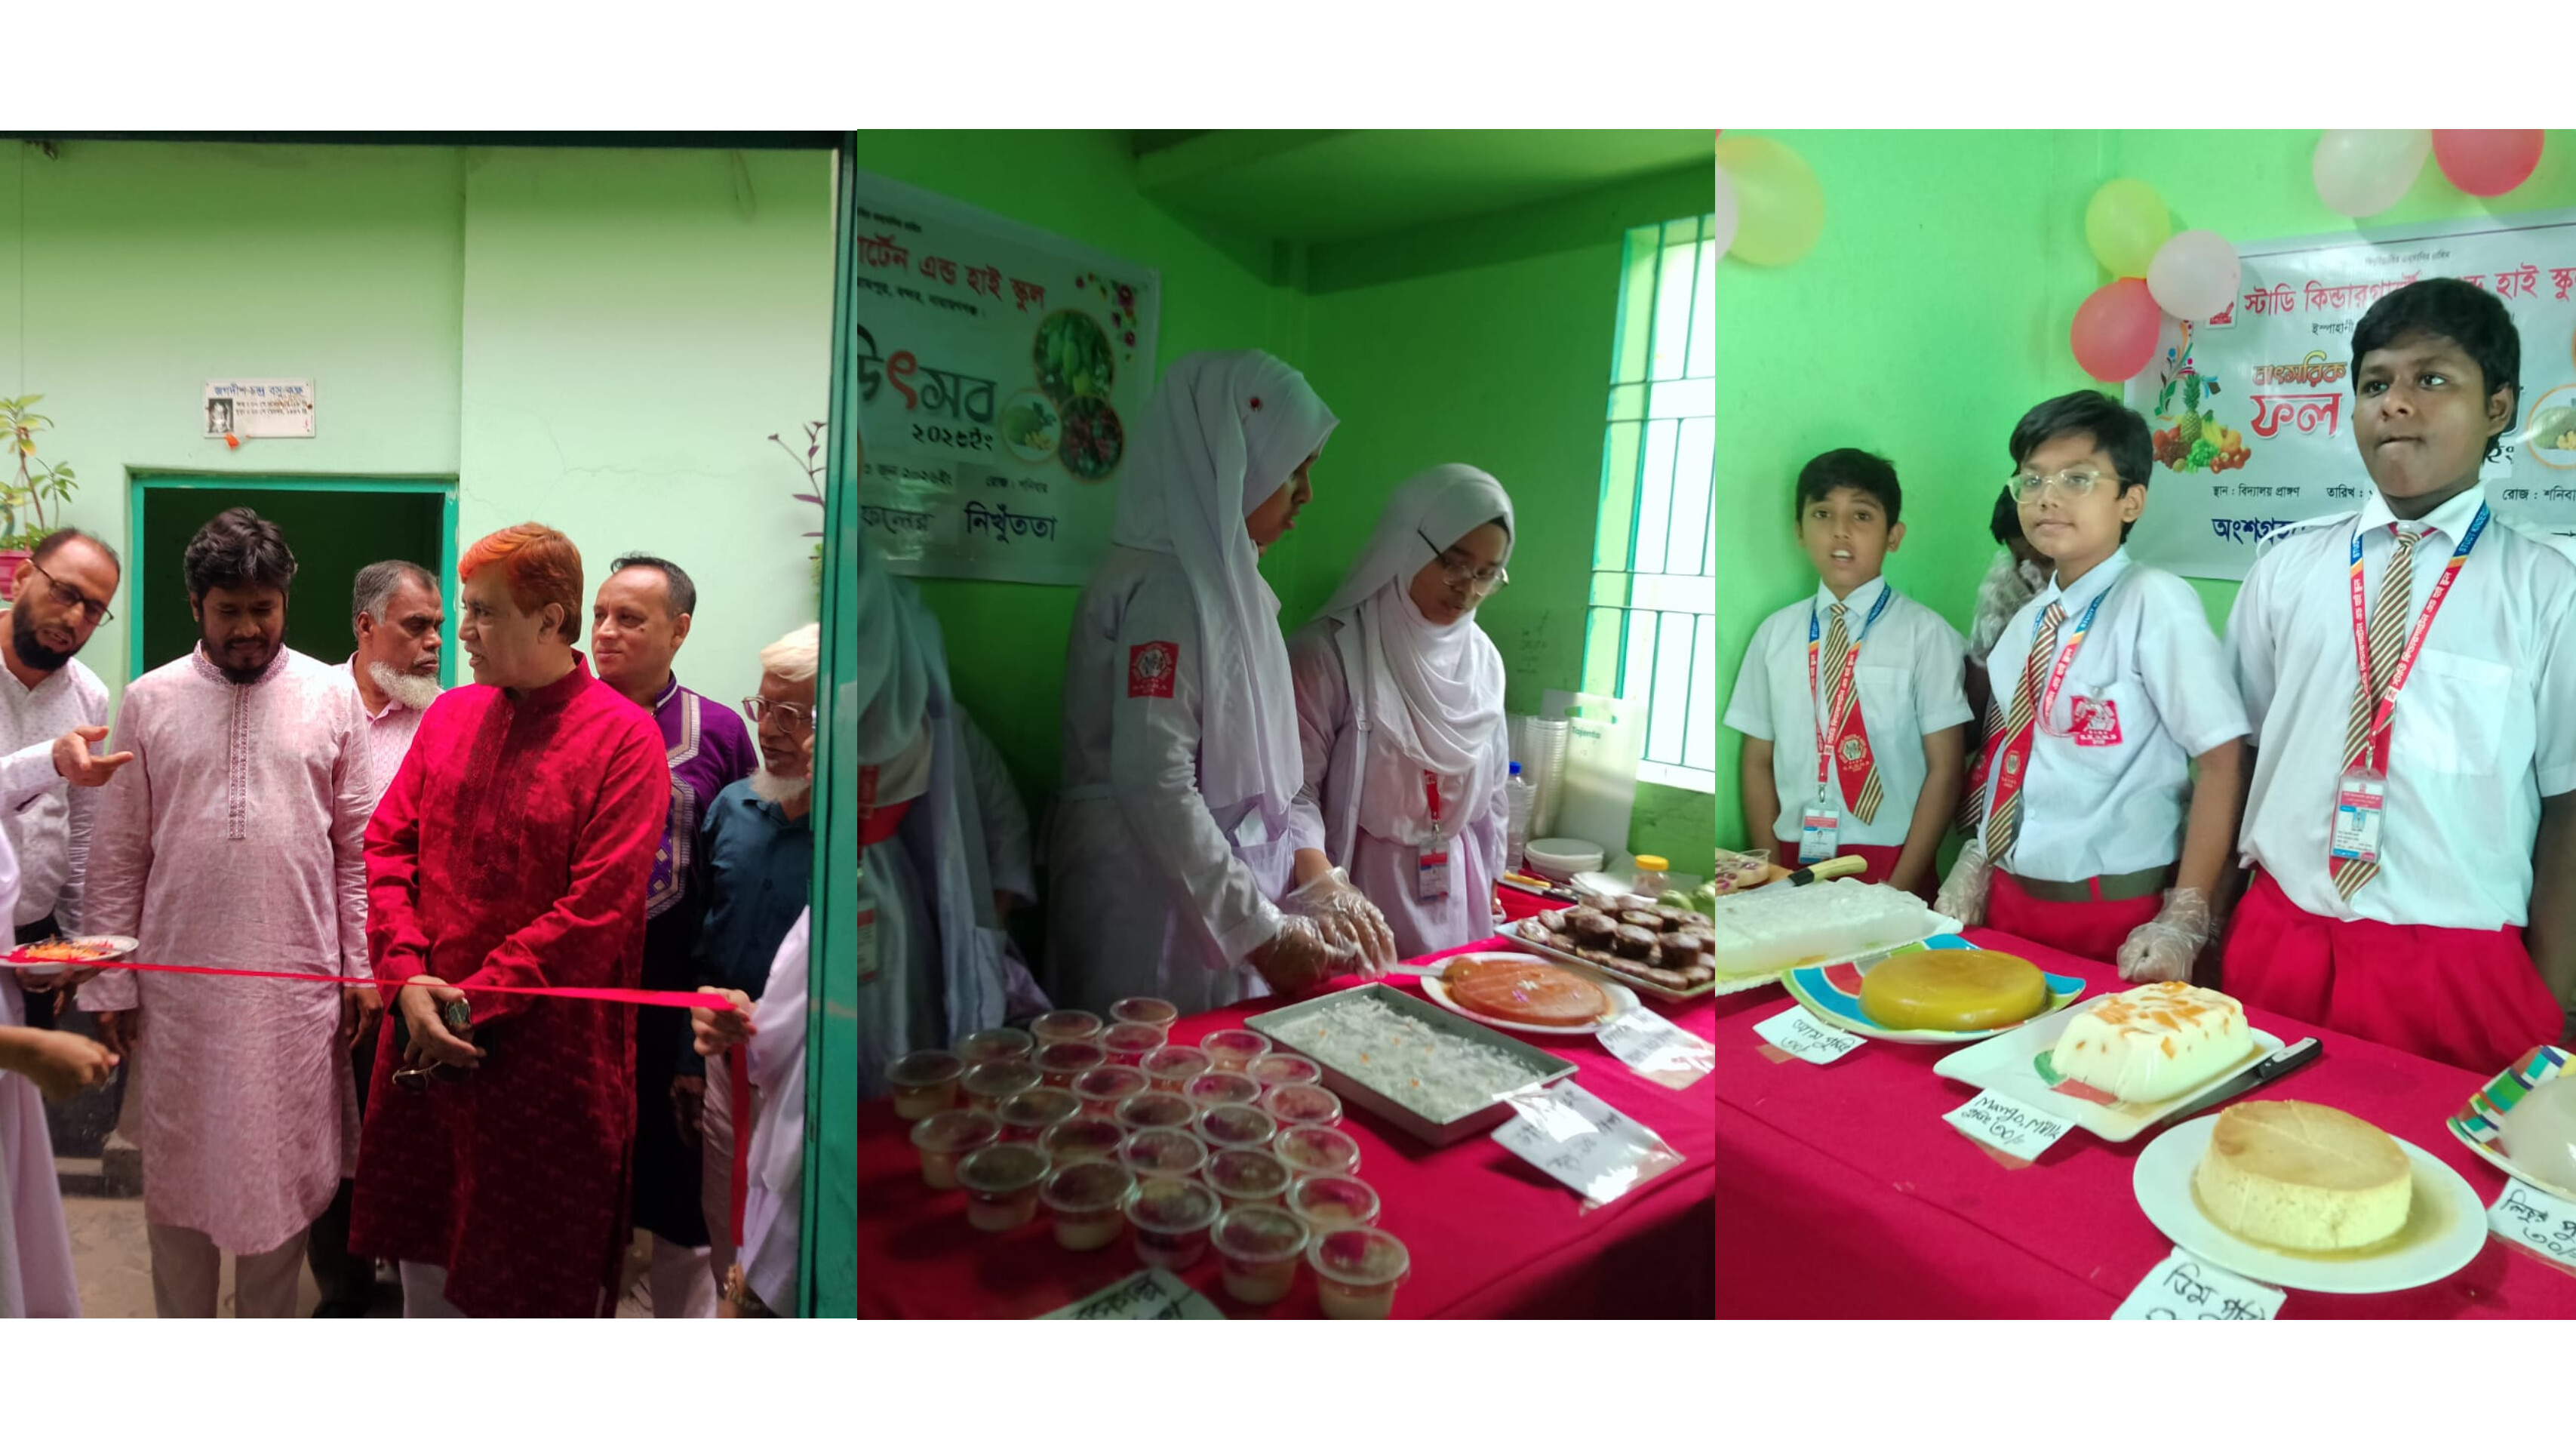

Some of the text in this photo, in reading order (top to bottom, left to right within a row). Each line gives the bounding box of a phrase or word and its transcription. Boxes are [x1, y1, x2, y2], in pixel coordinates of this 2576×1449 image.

[918, 255, 958, 287] এন্ড
[964, 262, 1004, 302] হাই
[1008, 276, 1046, 314] স্কুল
[2242, 282, 2297, 316] স্টাডি
[2493, 260, 2541, 301] হাই
[2547, 266, 2576, 303] স্কু
[2249, 392, 2344, 438] ফল
[2238, 482, 2273, 498] বিদ্যালয়
[2326, 484, 2356, 499] তারিখ
[2501, 488, 2529, 501] রোজ
[2543, 485, 2576, 501] শনিবা
[2352, 539, 2362, 559] STUD
[2458, 506, 2490, 553] STUDY KINDER
[2163, 1262, 2220, 1307] ডিম
